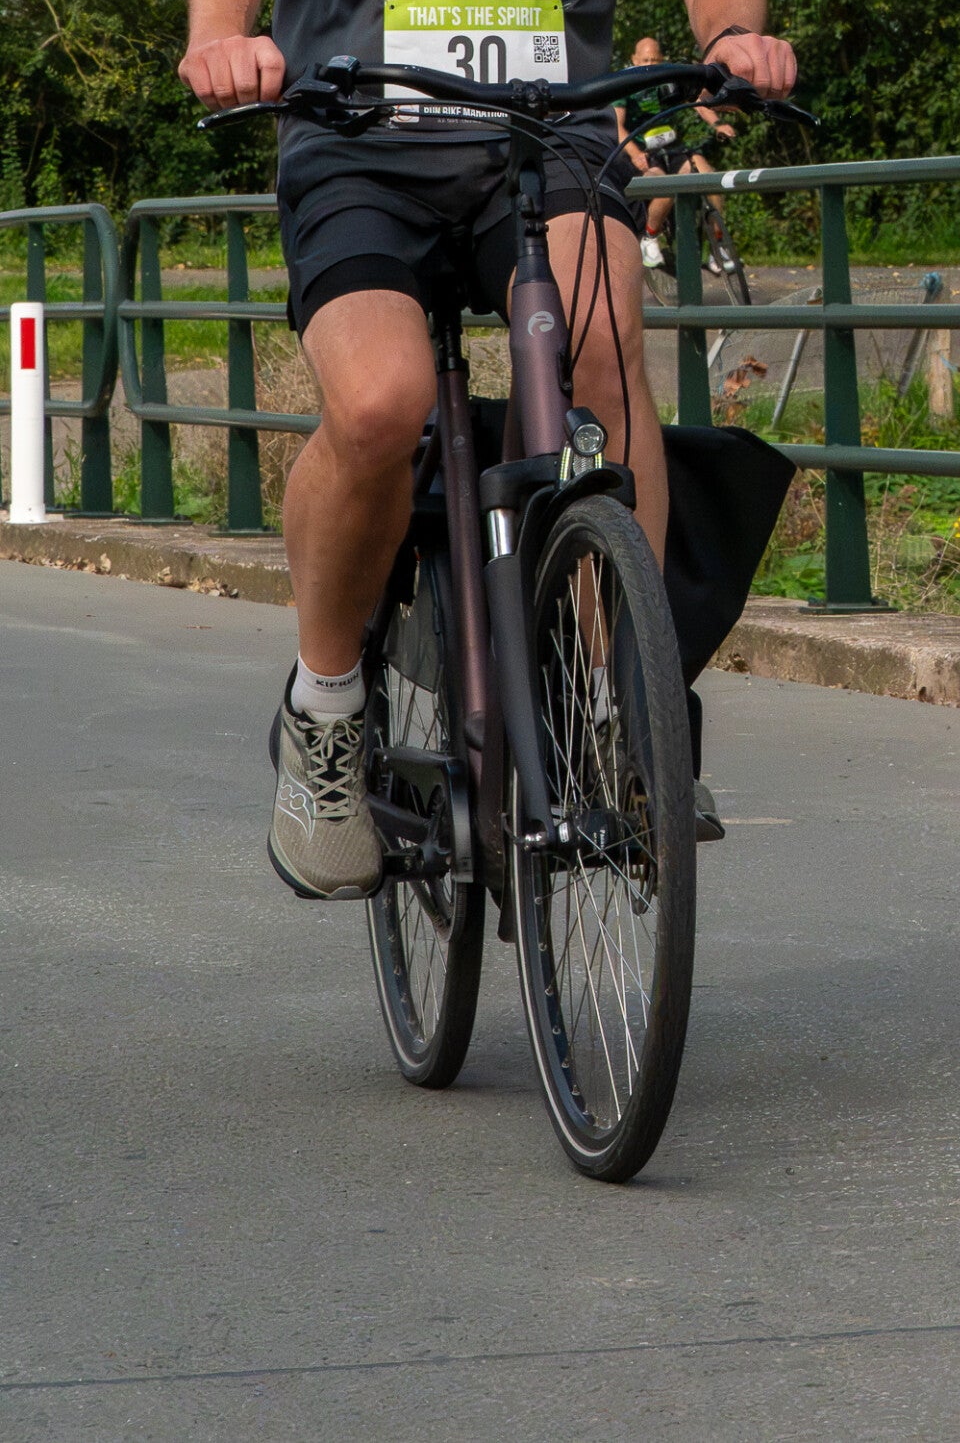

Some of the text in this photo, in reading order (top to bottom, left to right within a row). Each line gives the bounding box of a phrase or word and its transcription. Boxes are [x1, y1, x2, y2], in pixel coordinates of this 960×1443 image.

[407, 6, 542, 27] THAT'S THE SPIRIT
[447, 34, 507, 85] 30
